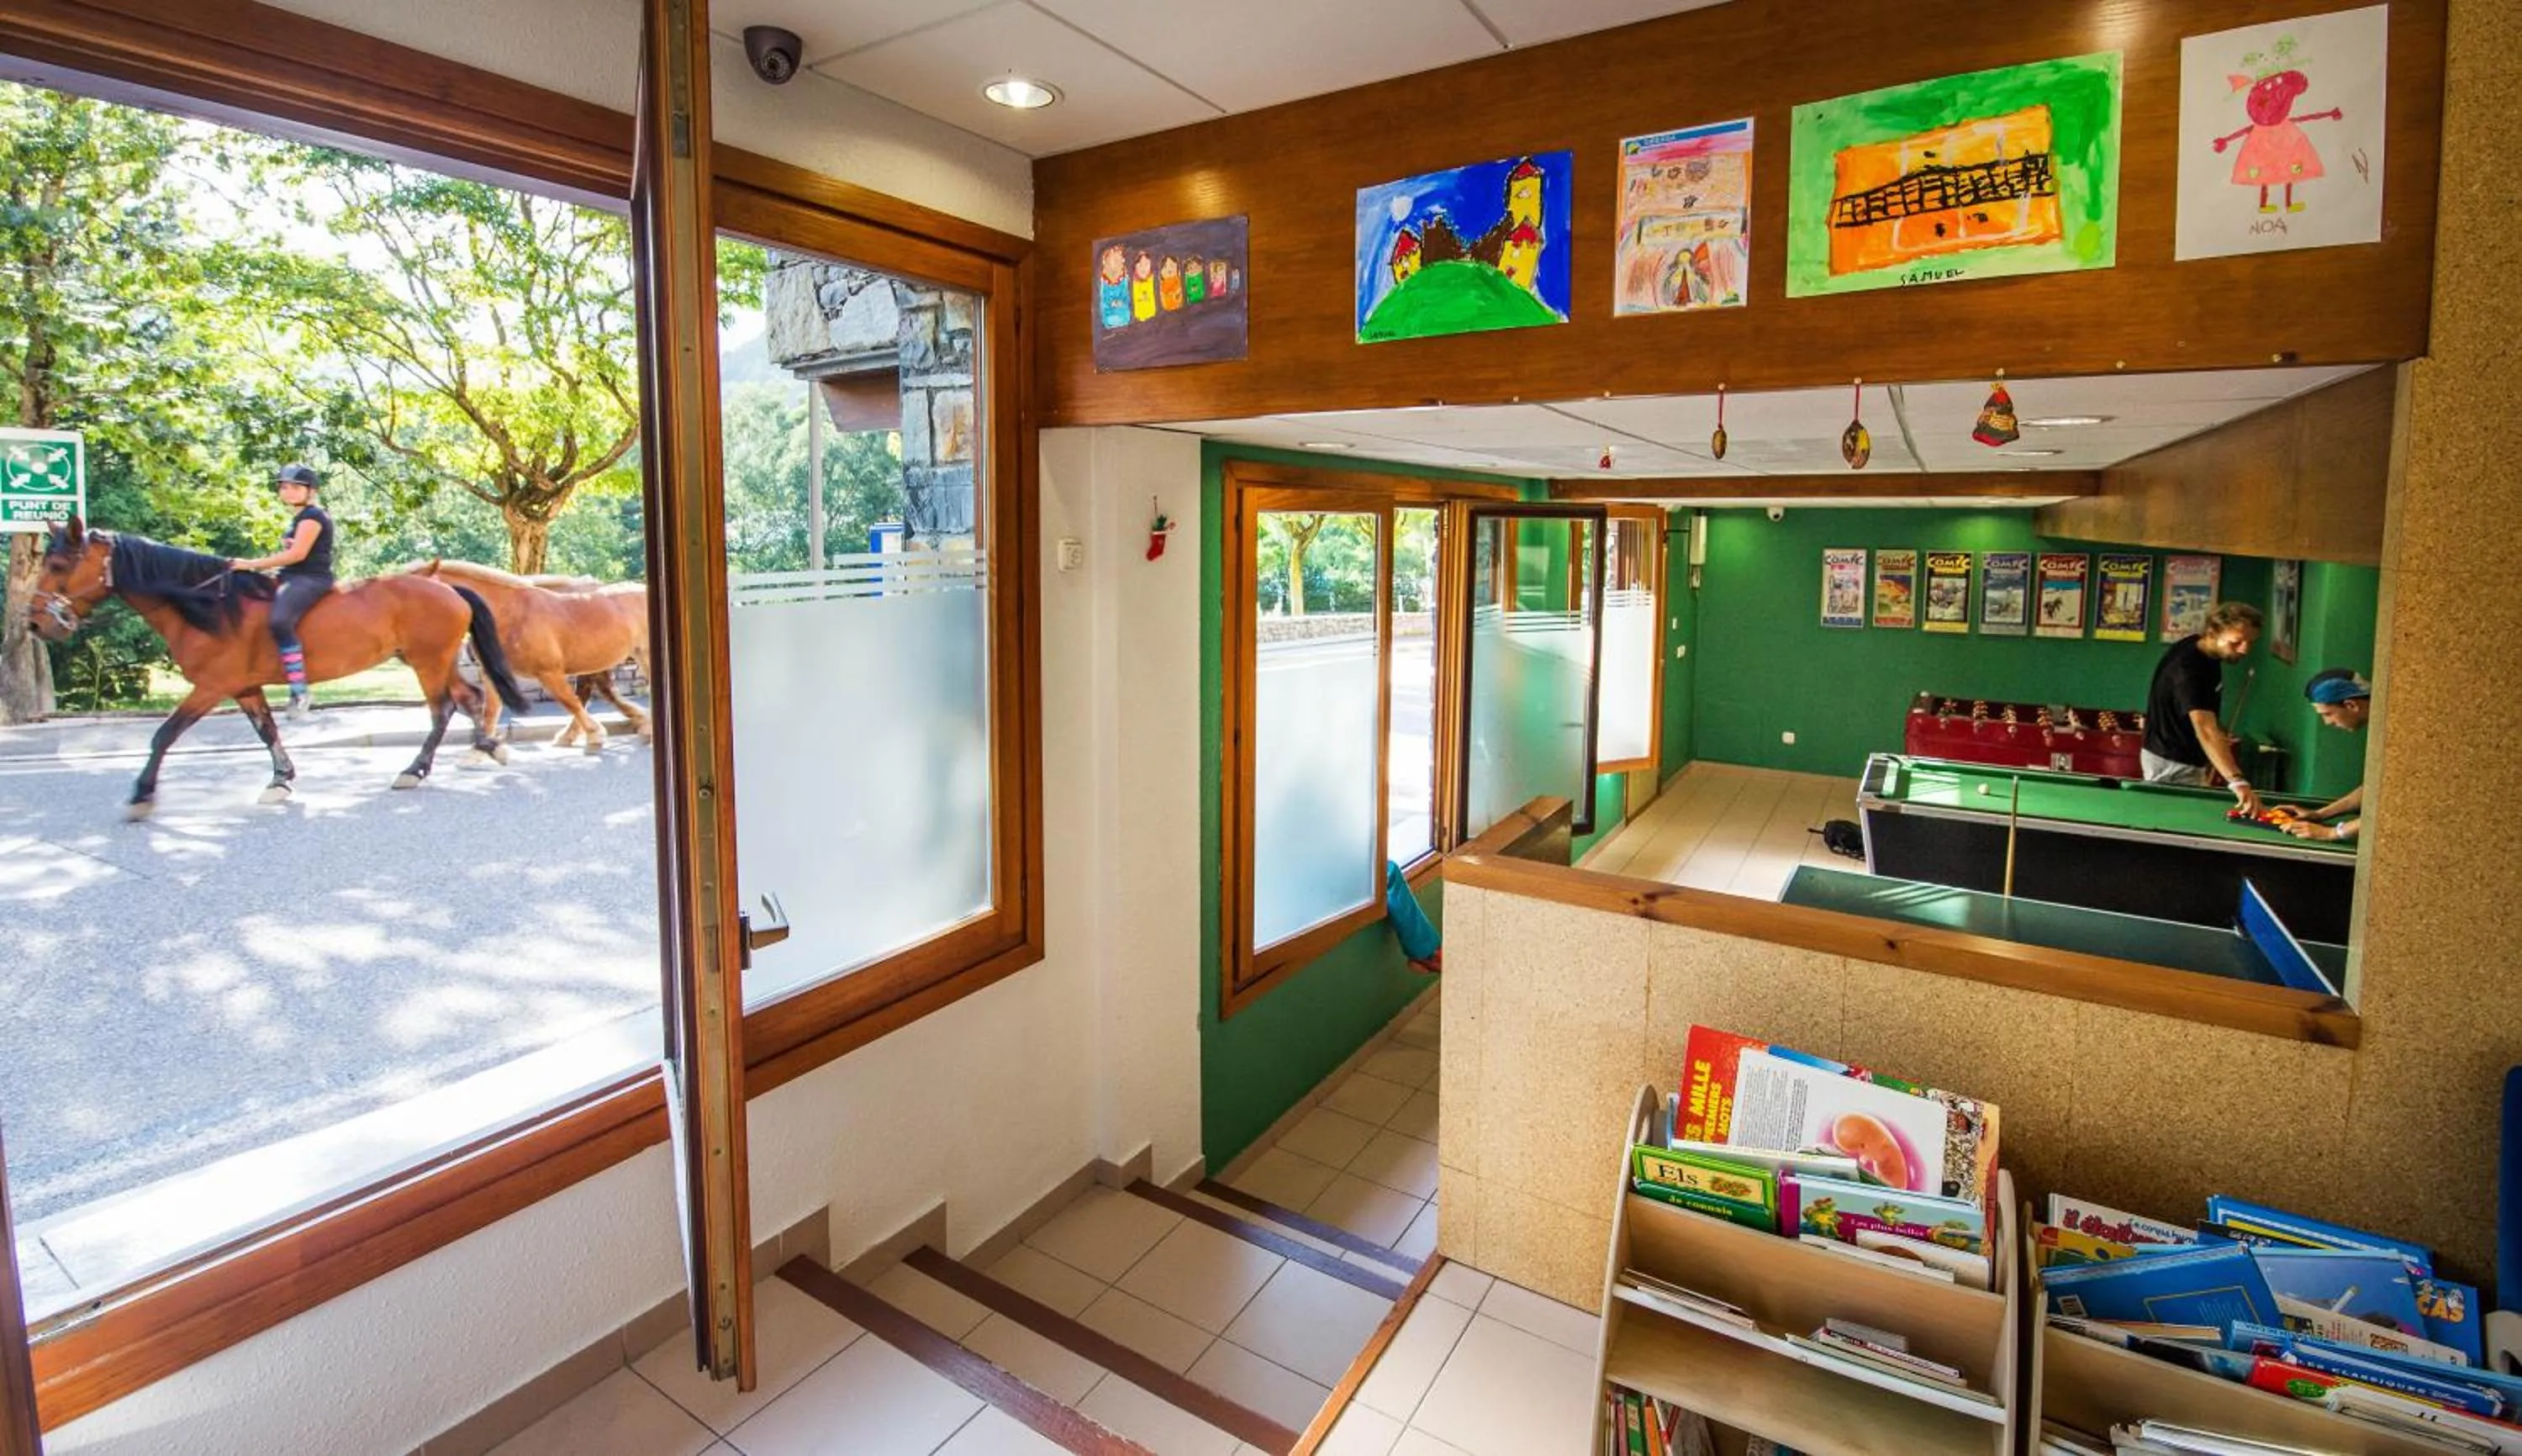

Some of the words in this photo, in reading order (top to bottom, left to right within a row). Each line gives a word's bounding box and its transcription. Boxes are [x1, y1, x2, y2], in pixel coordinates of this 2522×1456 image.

[2249, 217, 2287, 235] NOA
[1901, 269, 1964, 284] SAMUEL
[9, 501, 48, 510] PUNT
[51, 502, 71, 510] DE
[1689, 1059, 1711, 1117] MILLE
[1717, 1096, 1733, 1136] MOTS
[1659, 1164, 1699, 1184] Els
